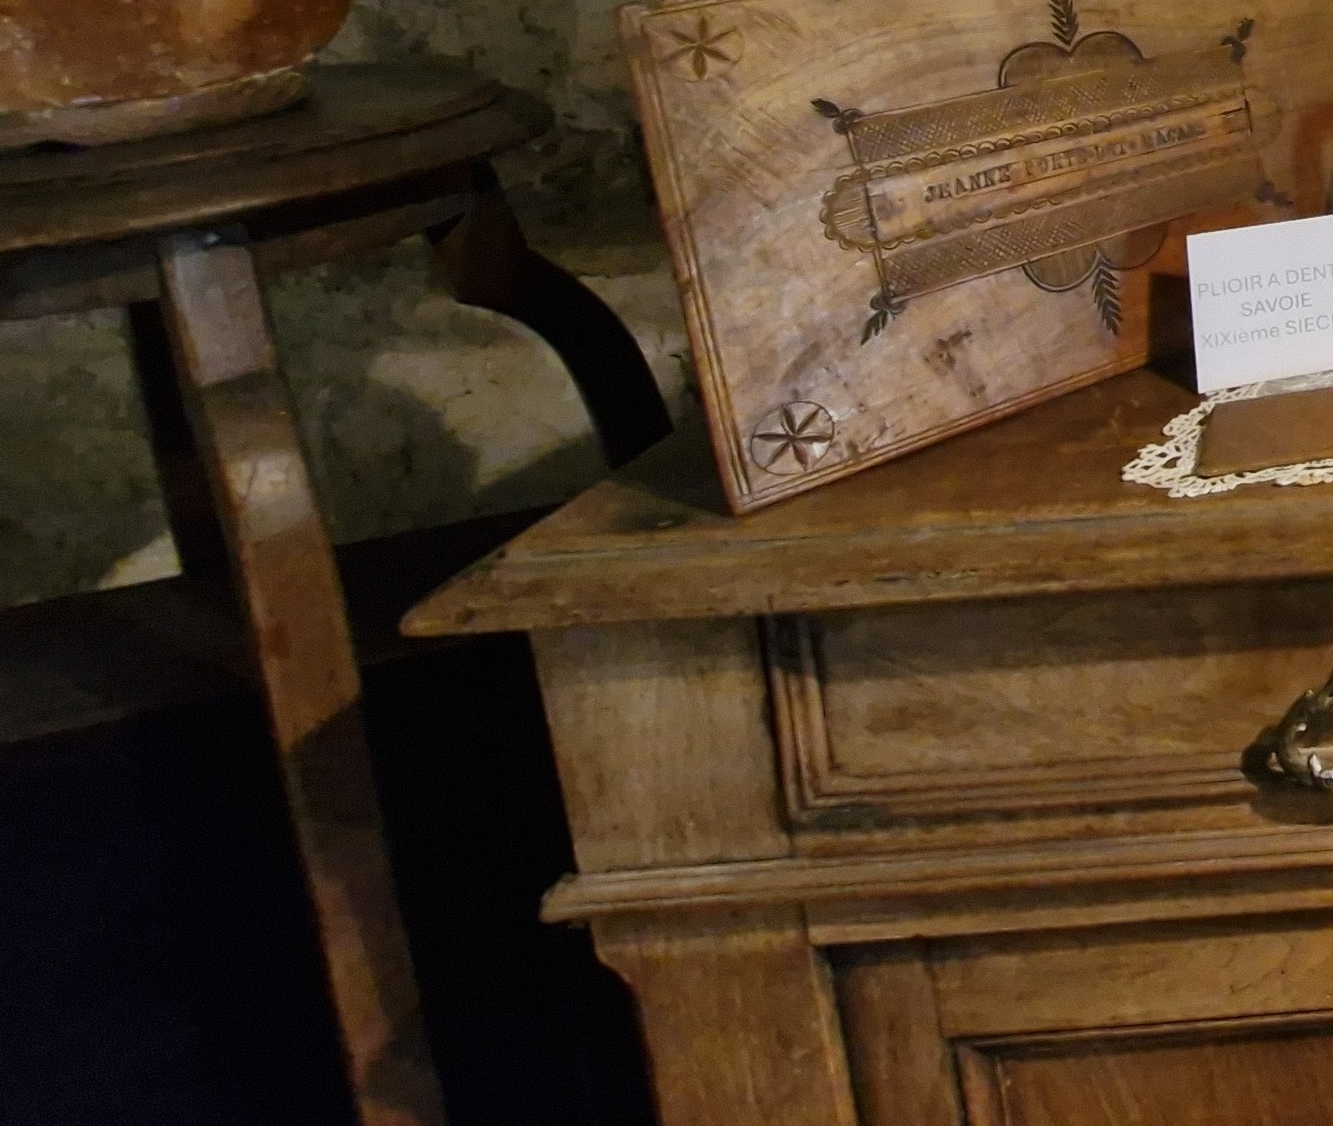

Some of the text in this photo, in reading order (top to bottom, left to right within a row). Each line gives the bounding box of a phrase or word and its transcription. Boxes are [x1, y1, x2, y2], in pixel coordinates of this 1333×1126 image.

[1197, 275, 1262, 299] PLIOIR
[1267, 274, 1281, 287] A
[1241, 292, 1313, 317] SAVOIE
